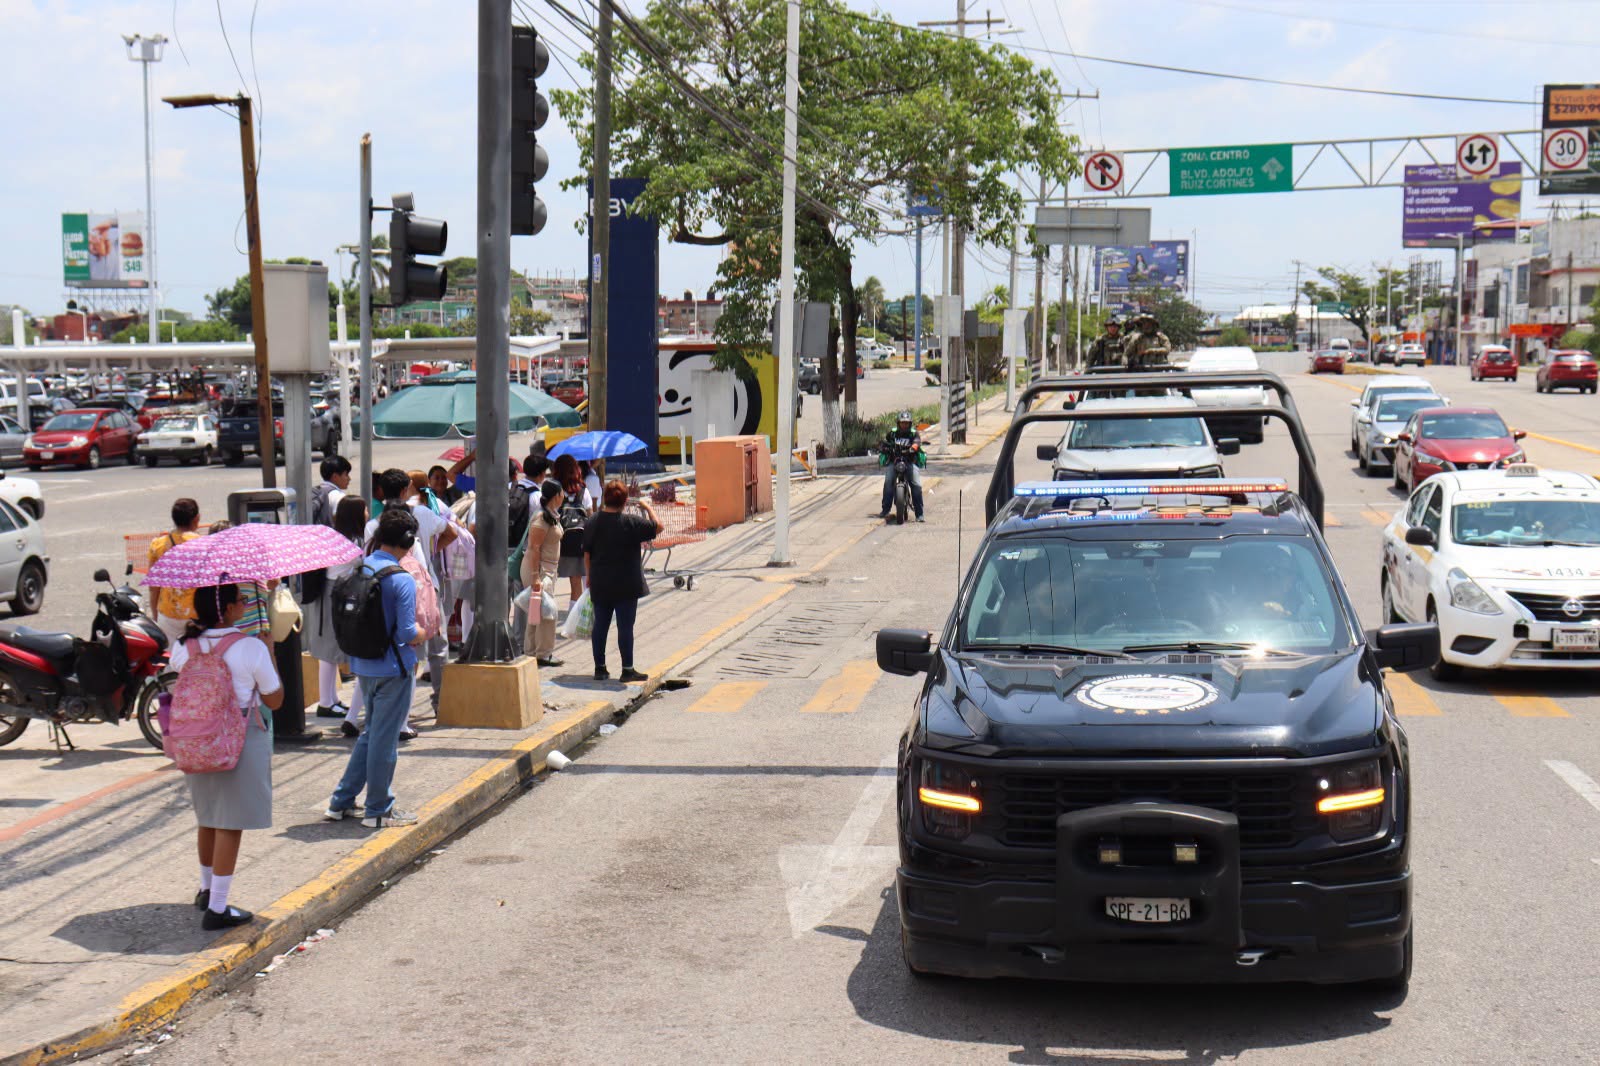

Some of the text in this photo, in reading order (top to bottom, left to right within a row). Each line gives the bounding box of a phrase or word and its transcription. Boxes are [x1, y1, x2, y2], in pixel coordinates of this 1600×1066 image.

[1556, 138, 1576, 156] 30
[1180, 150, 1250, 162] ZONA CENTRO
[1180, 167, 1254, 179] BLVD. ADOLFO
[1181, 178, 1255, 190] RUIZ CORTINES
[1406, 186, 1458, 195] Tus compras
[1406, 196, 1450, 204] al contado
[1416, 205, 1474, 215] recompensan
[1511, 466, 1535, 474] TAXI
[1545, 568, 1584, 577] 1434
